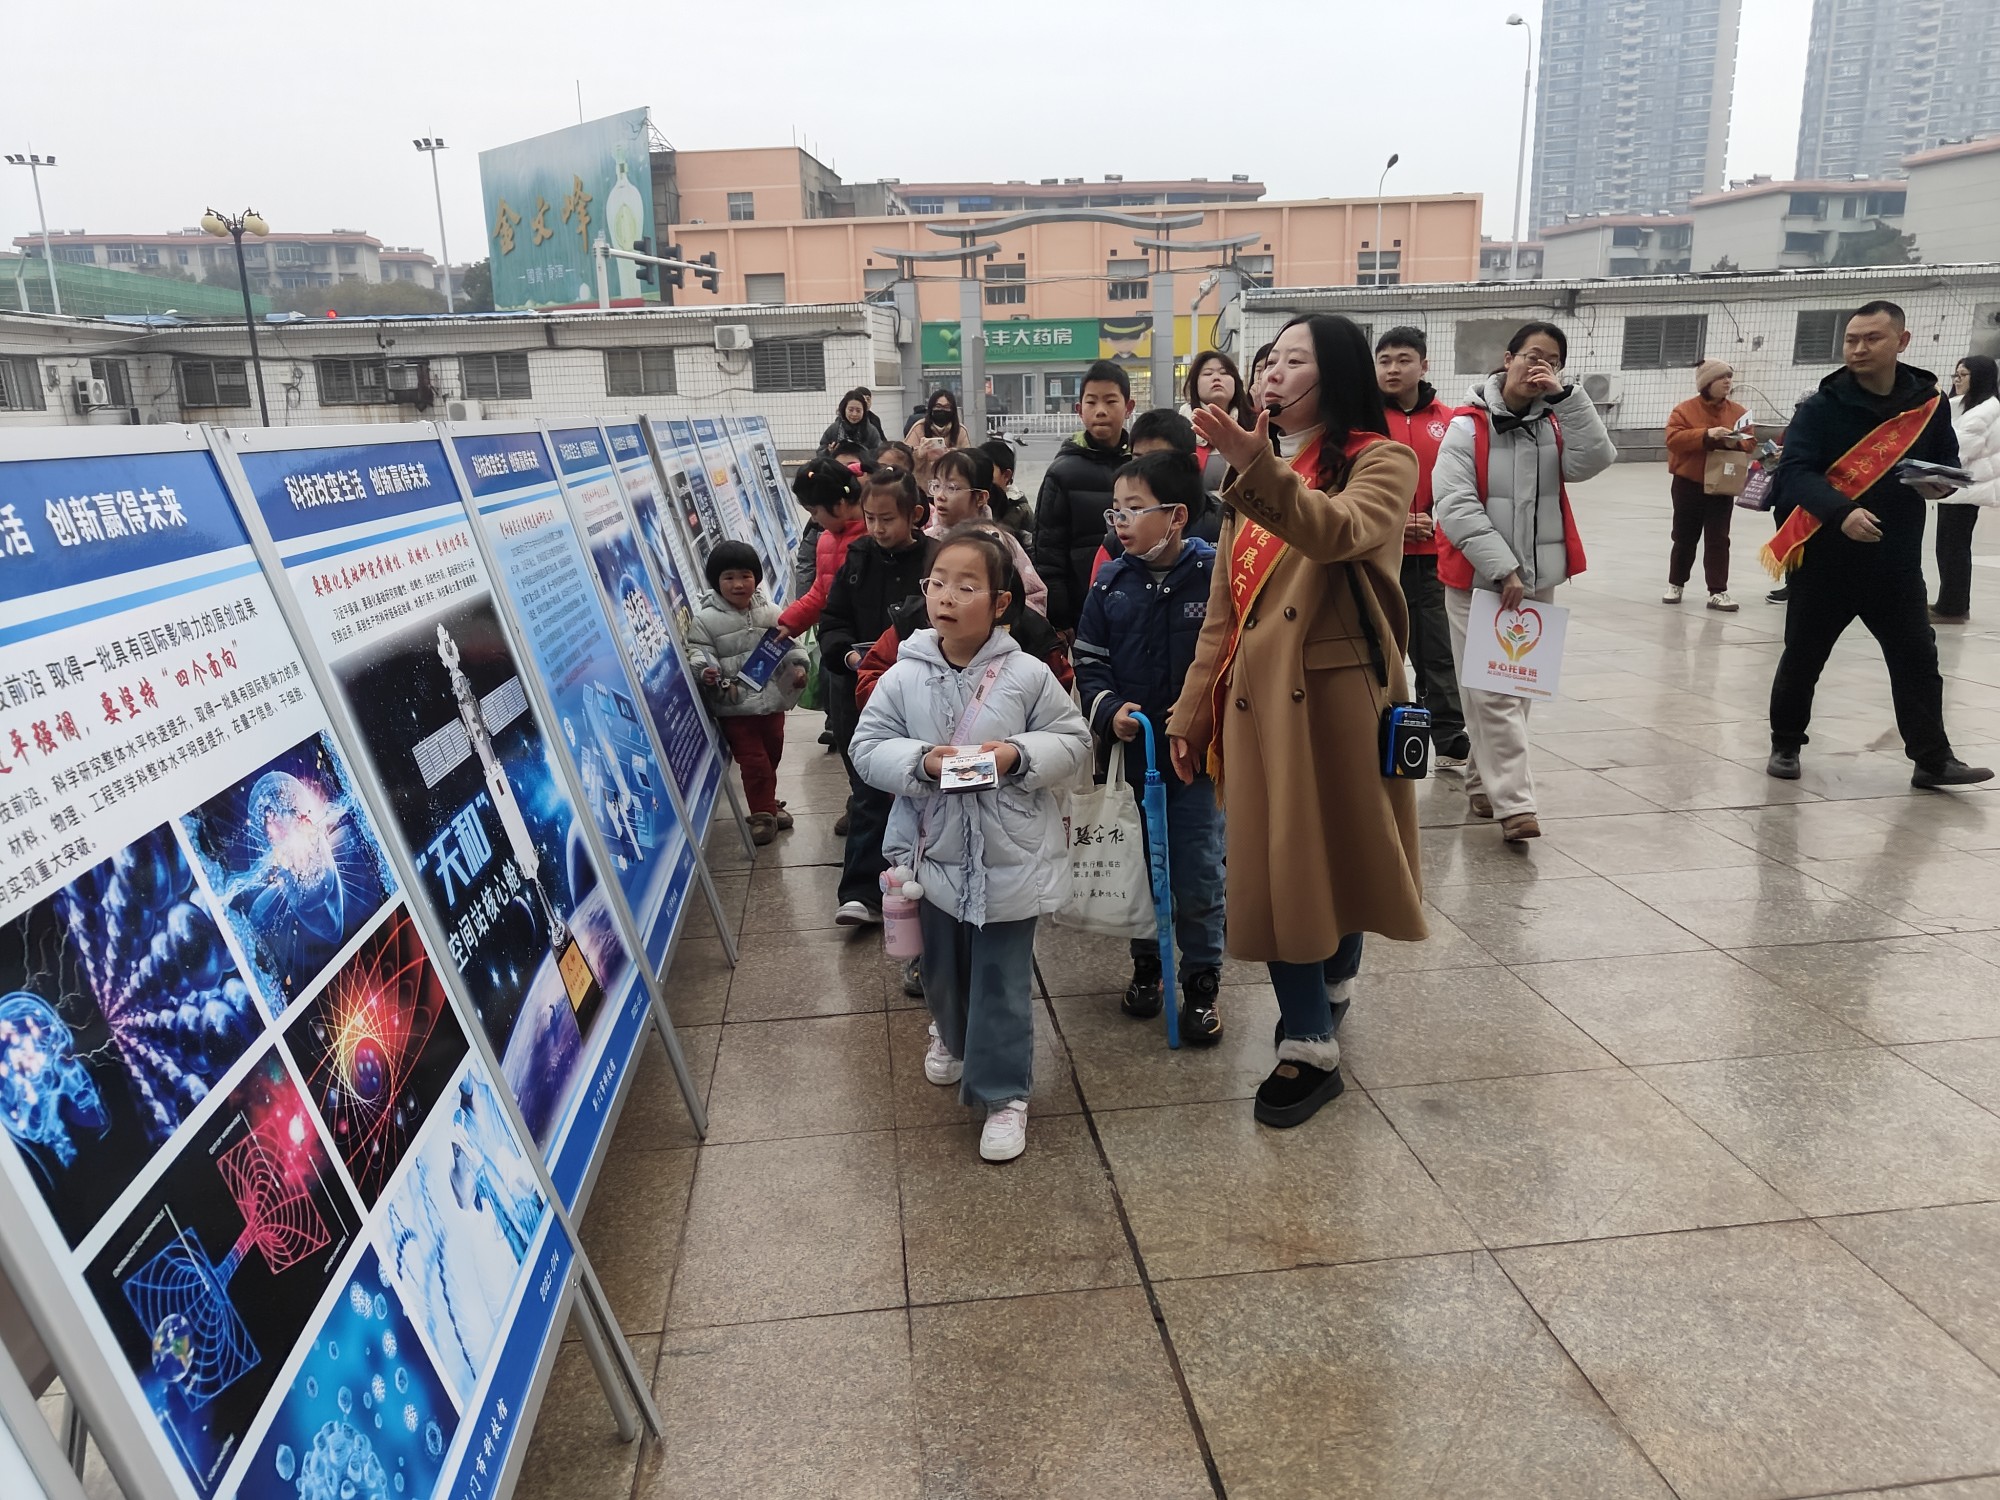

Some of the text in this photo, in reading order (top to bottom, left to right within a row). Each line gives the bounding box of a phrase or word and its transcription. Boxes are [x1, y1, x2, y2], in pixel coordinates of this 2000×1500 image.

[0, 485, 188, 558] 活 创新赢得未来
[284, 461, 431, 511] 科技改变生活 创新赢得未来
[1233, 523, 1271, 609] 馆展厅
[45, 597, 258, 690] 取得一批具有国际影响力的原创成果
[1488, 660, 1537, 677] 爱心托管班
[447, 859, 522, 974] 空间站核心舱
